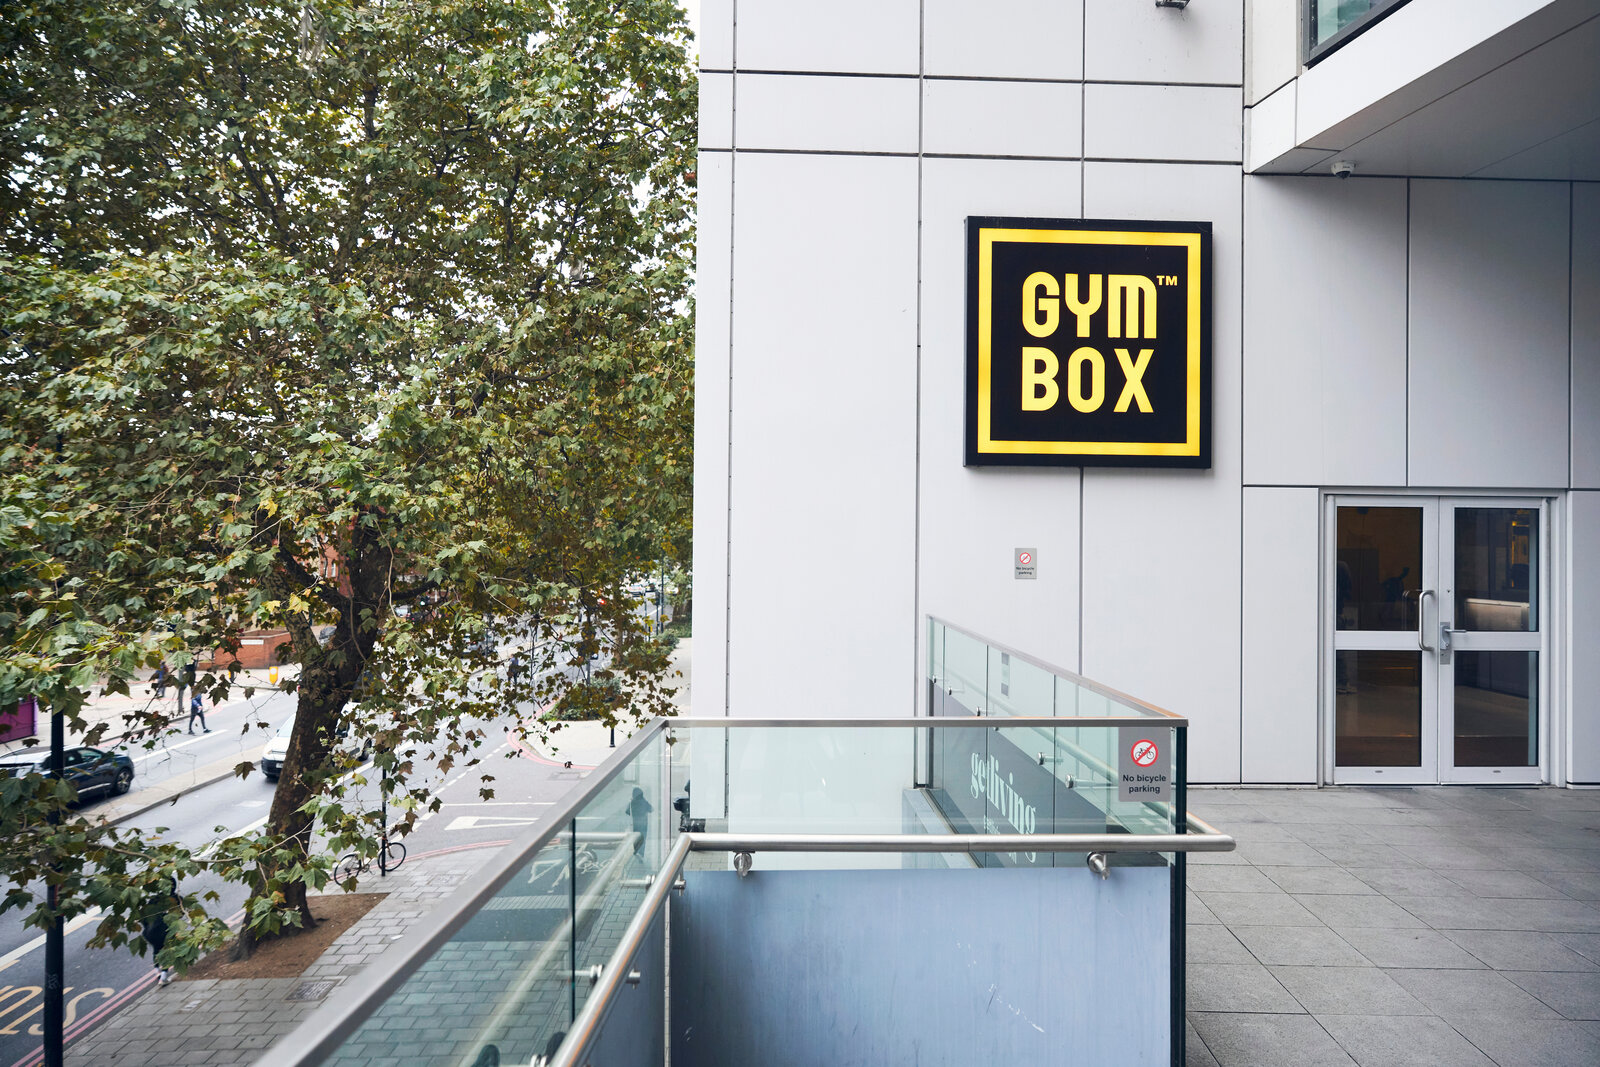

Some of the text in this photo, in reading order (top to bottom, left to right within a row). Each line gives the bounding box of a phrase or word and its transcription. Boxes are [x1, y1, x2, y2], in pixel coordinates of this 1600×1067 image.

[1022, 346, 1154, 413] BOX
[1123, 774, 1167, 783] No bicycle
[1128, 785, 1161, 794] parking
